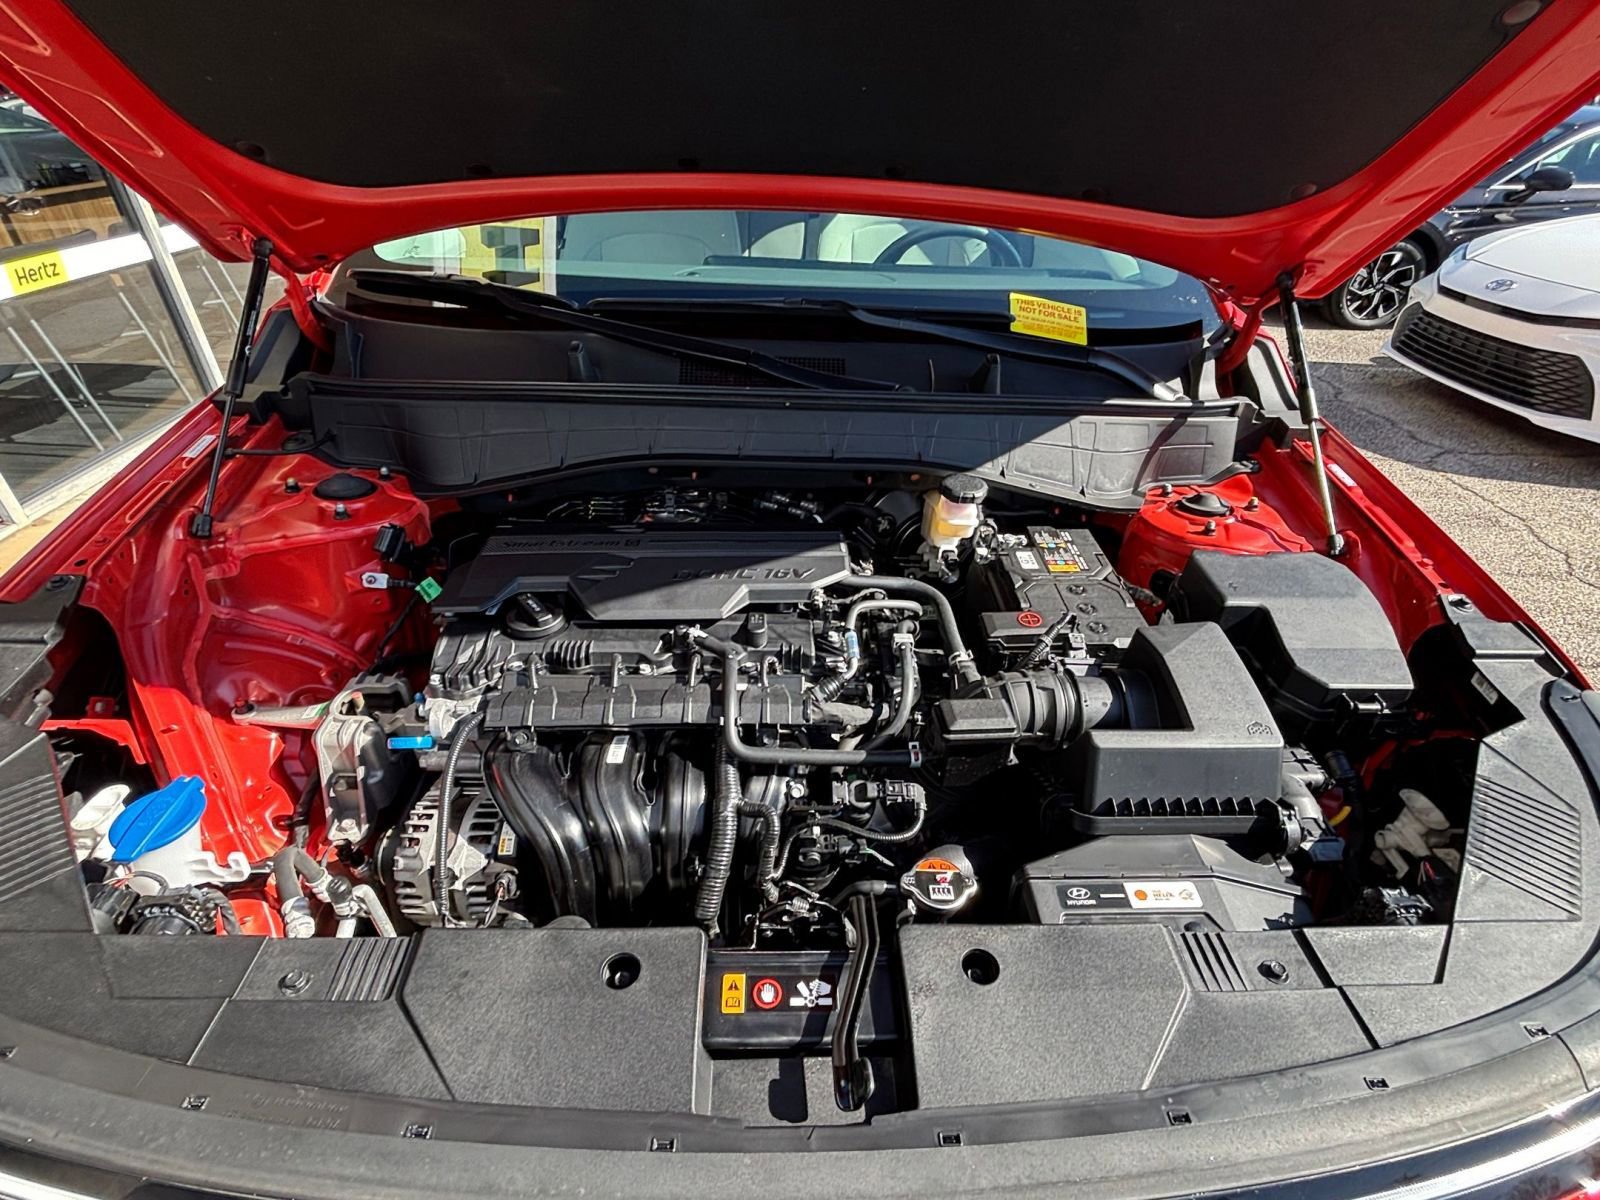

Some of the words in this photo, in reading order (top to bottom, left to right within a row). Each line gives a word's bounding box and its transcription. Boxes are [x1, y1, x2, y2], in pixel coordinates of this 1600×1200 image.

[14, 262, 60, 286] Hertz
[1016, 298, 1035, 307] THIS
[1037, 301, 1073, 315] VEHICLE
[1074, 308, 1082, 317] IS
[1019, 305, 1038, 315] NOT
[1038, 309, 1056, 319] FOR
[1057, 313, 1080, 323] SALE
[764, 568, 816, 580] 16V
